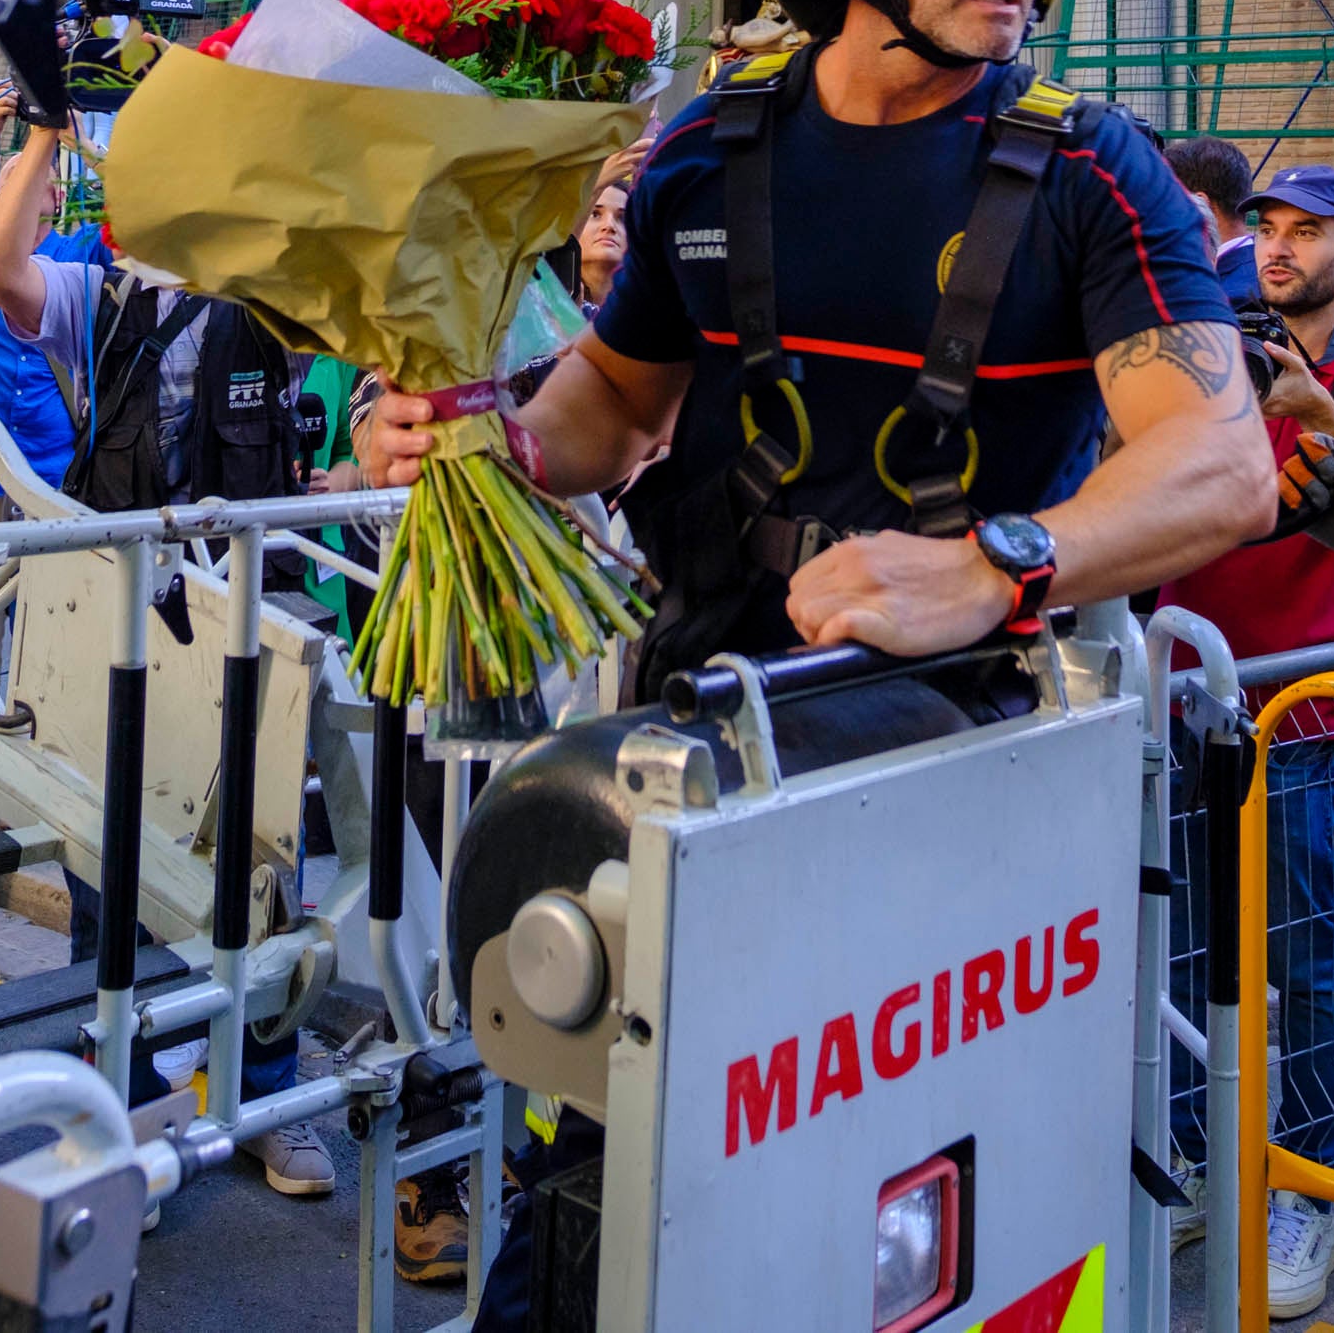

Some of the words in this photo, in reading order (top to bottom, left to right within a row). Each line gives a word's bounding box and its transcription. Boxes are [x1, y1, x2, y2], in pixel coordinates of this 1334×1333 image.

[150, 1, 193, 10] GRANADA
[679, 245, 727, 260] GRANA
[229, 382, 265, 401] PTV
[229, 399, 264, 409] GRANADA
[725, 907, 1100, 1159] MAGIRUS
